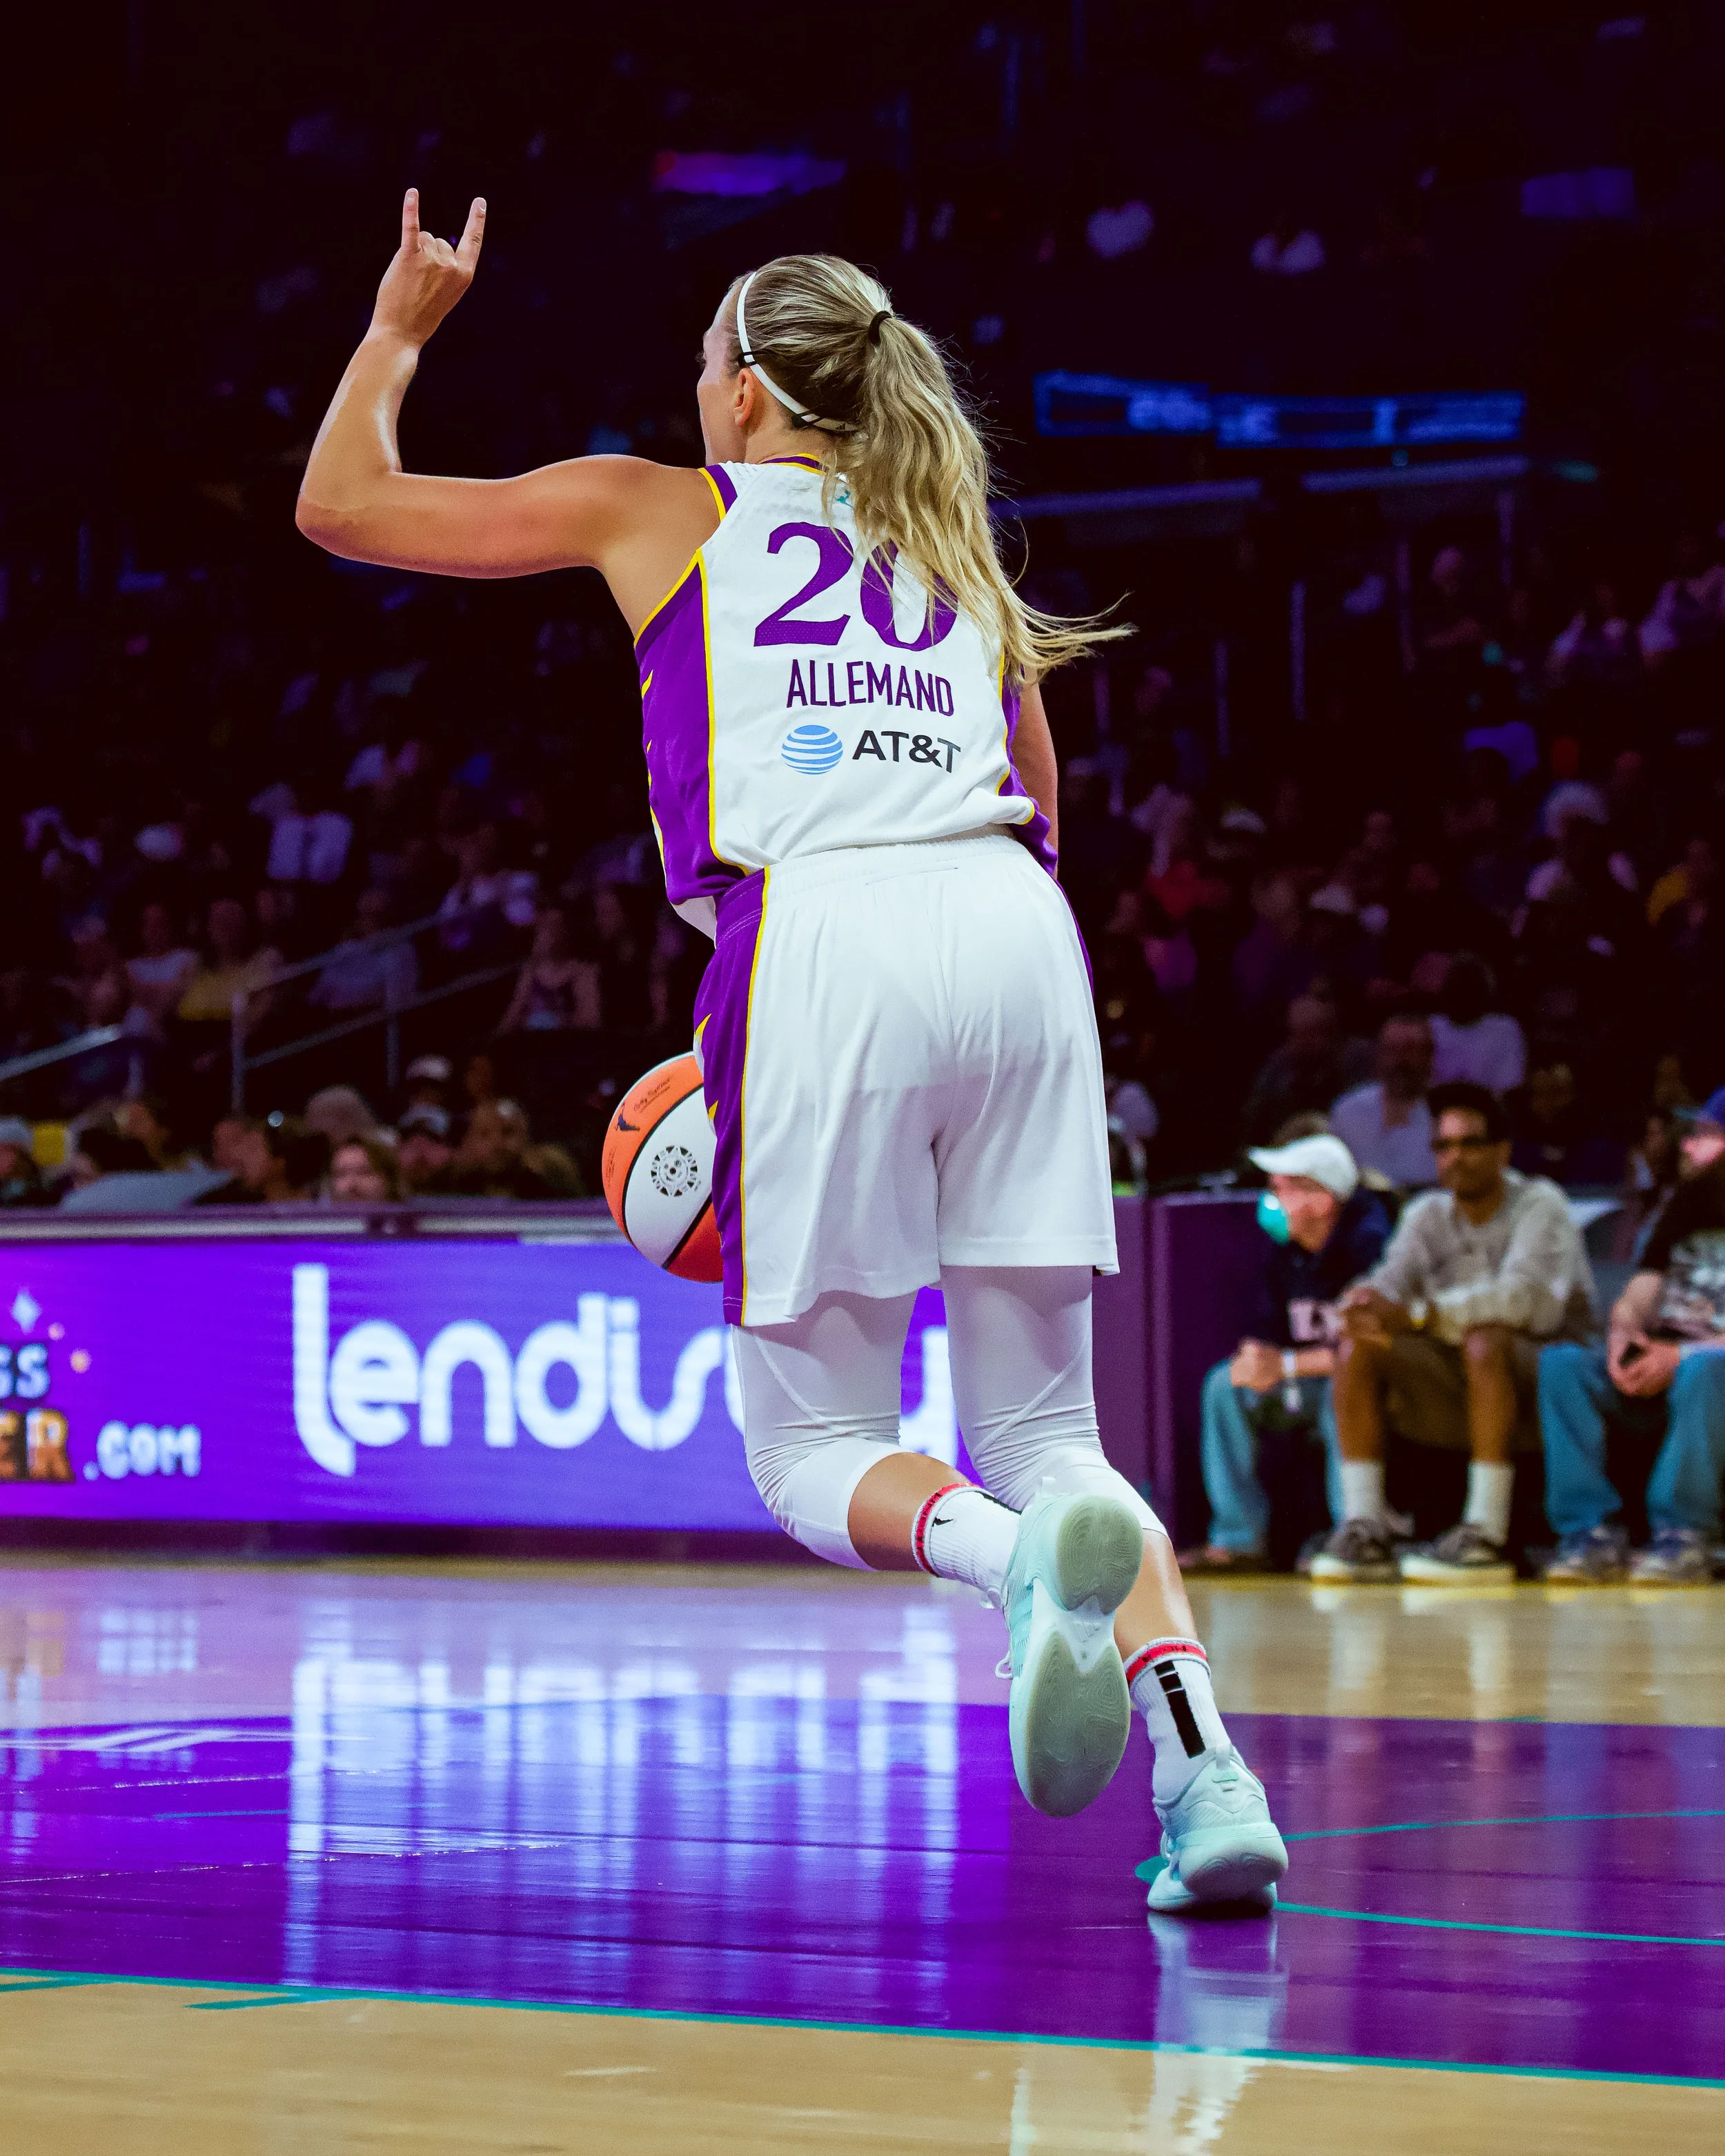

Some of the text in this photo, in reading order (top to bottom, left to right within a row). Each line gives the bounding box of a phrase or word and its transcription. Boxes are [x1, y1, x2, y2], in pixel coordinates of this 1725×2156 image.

[753, 522, 958, 651] 20
[787, 659, 954, 716] ALLEMAND
[852, 730, 961, 773] AT&T
